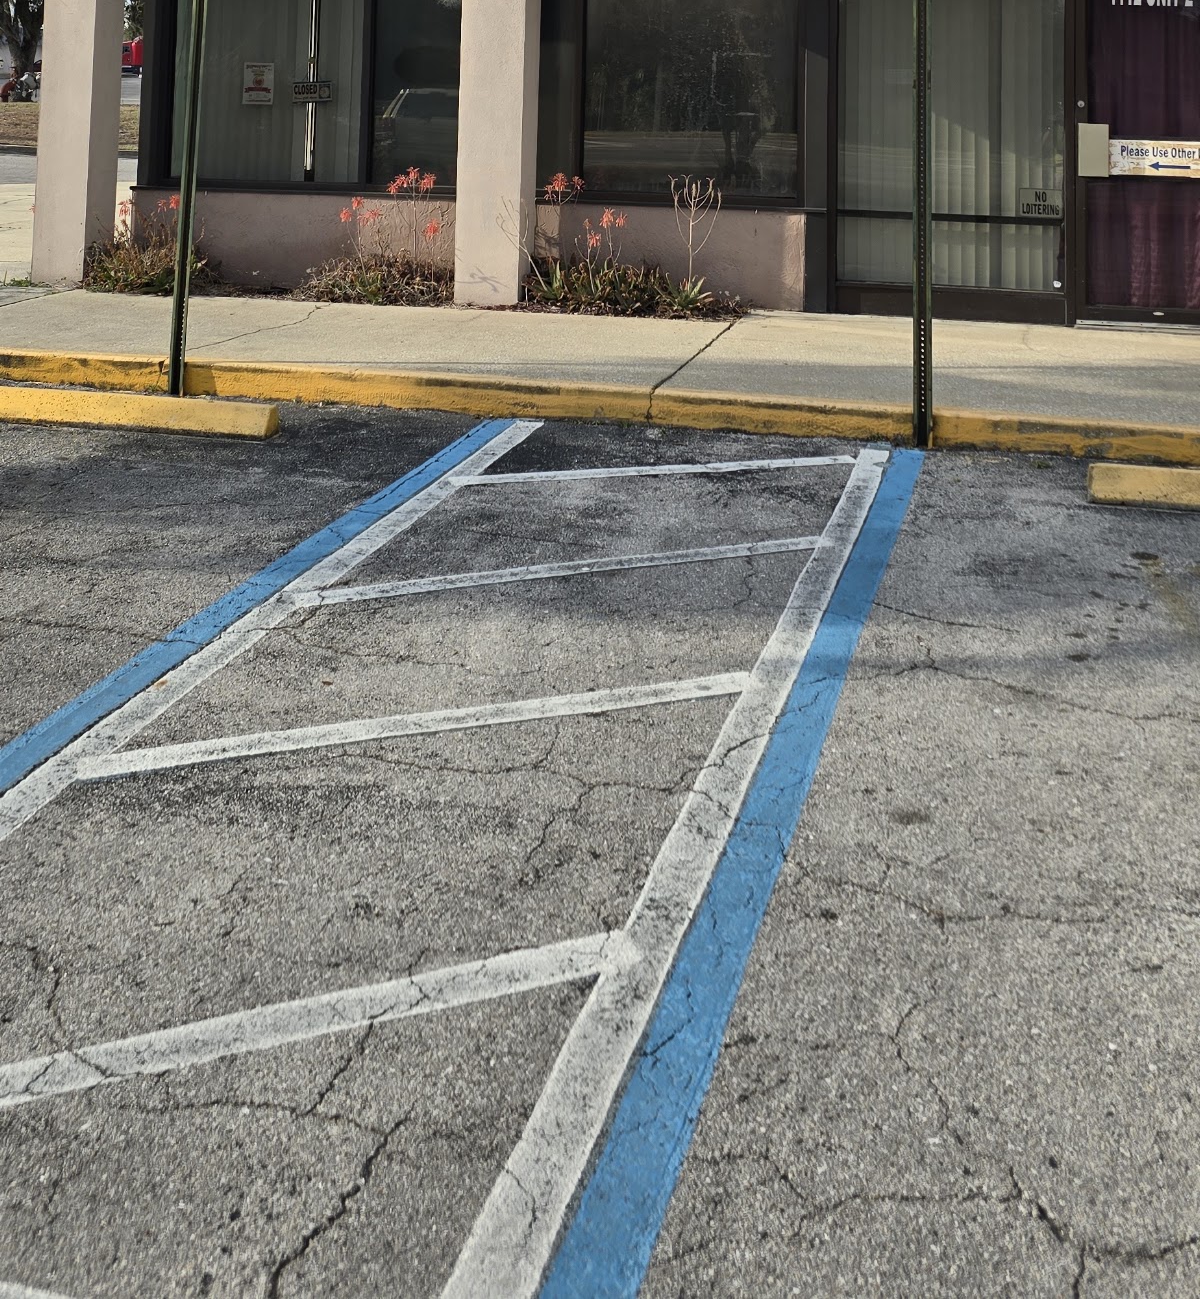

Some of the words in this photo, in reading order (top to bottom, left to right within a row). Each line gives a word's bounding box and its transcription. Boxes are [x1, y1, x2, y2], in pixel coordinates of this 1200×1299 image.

[293, 84, 318, 95] CLOSED
[1120, 145, 1150, 157] Please
[1152, 147, 1169, 158] Use
[1171, 147, 1196, 159] Other
[1034, 191, 1047, 202] NO
[1021, 203, 1060, 216] LOITERING
